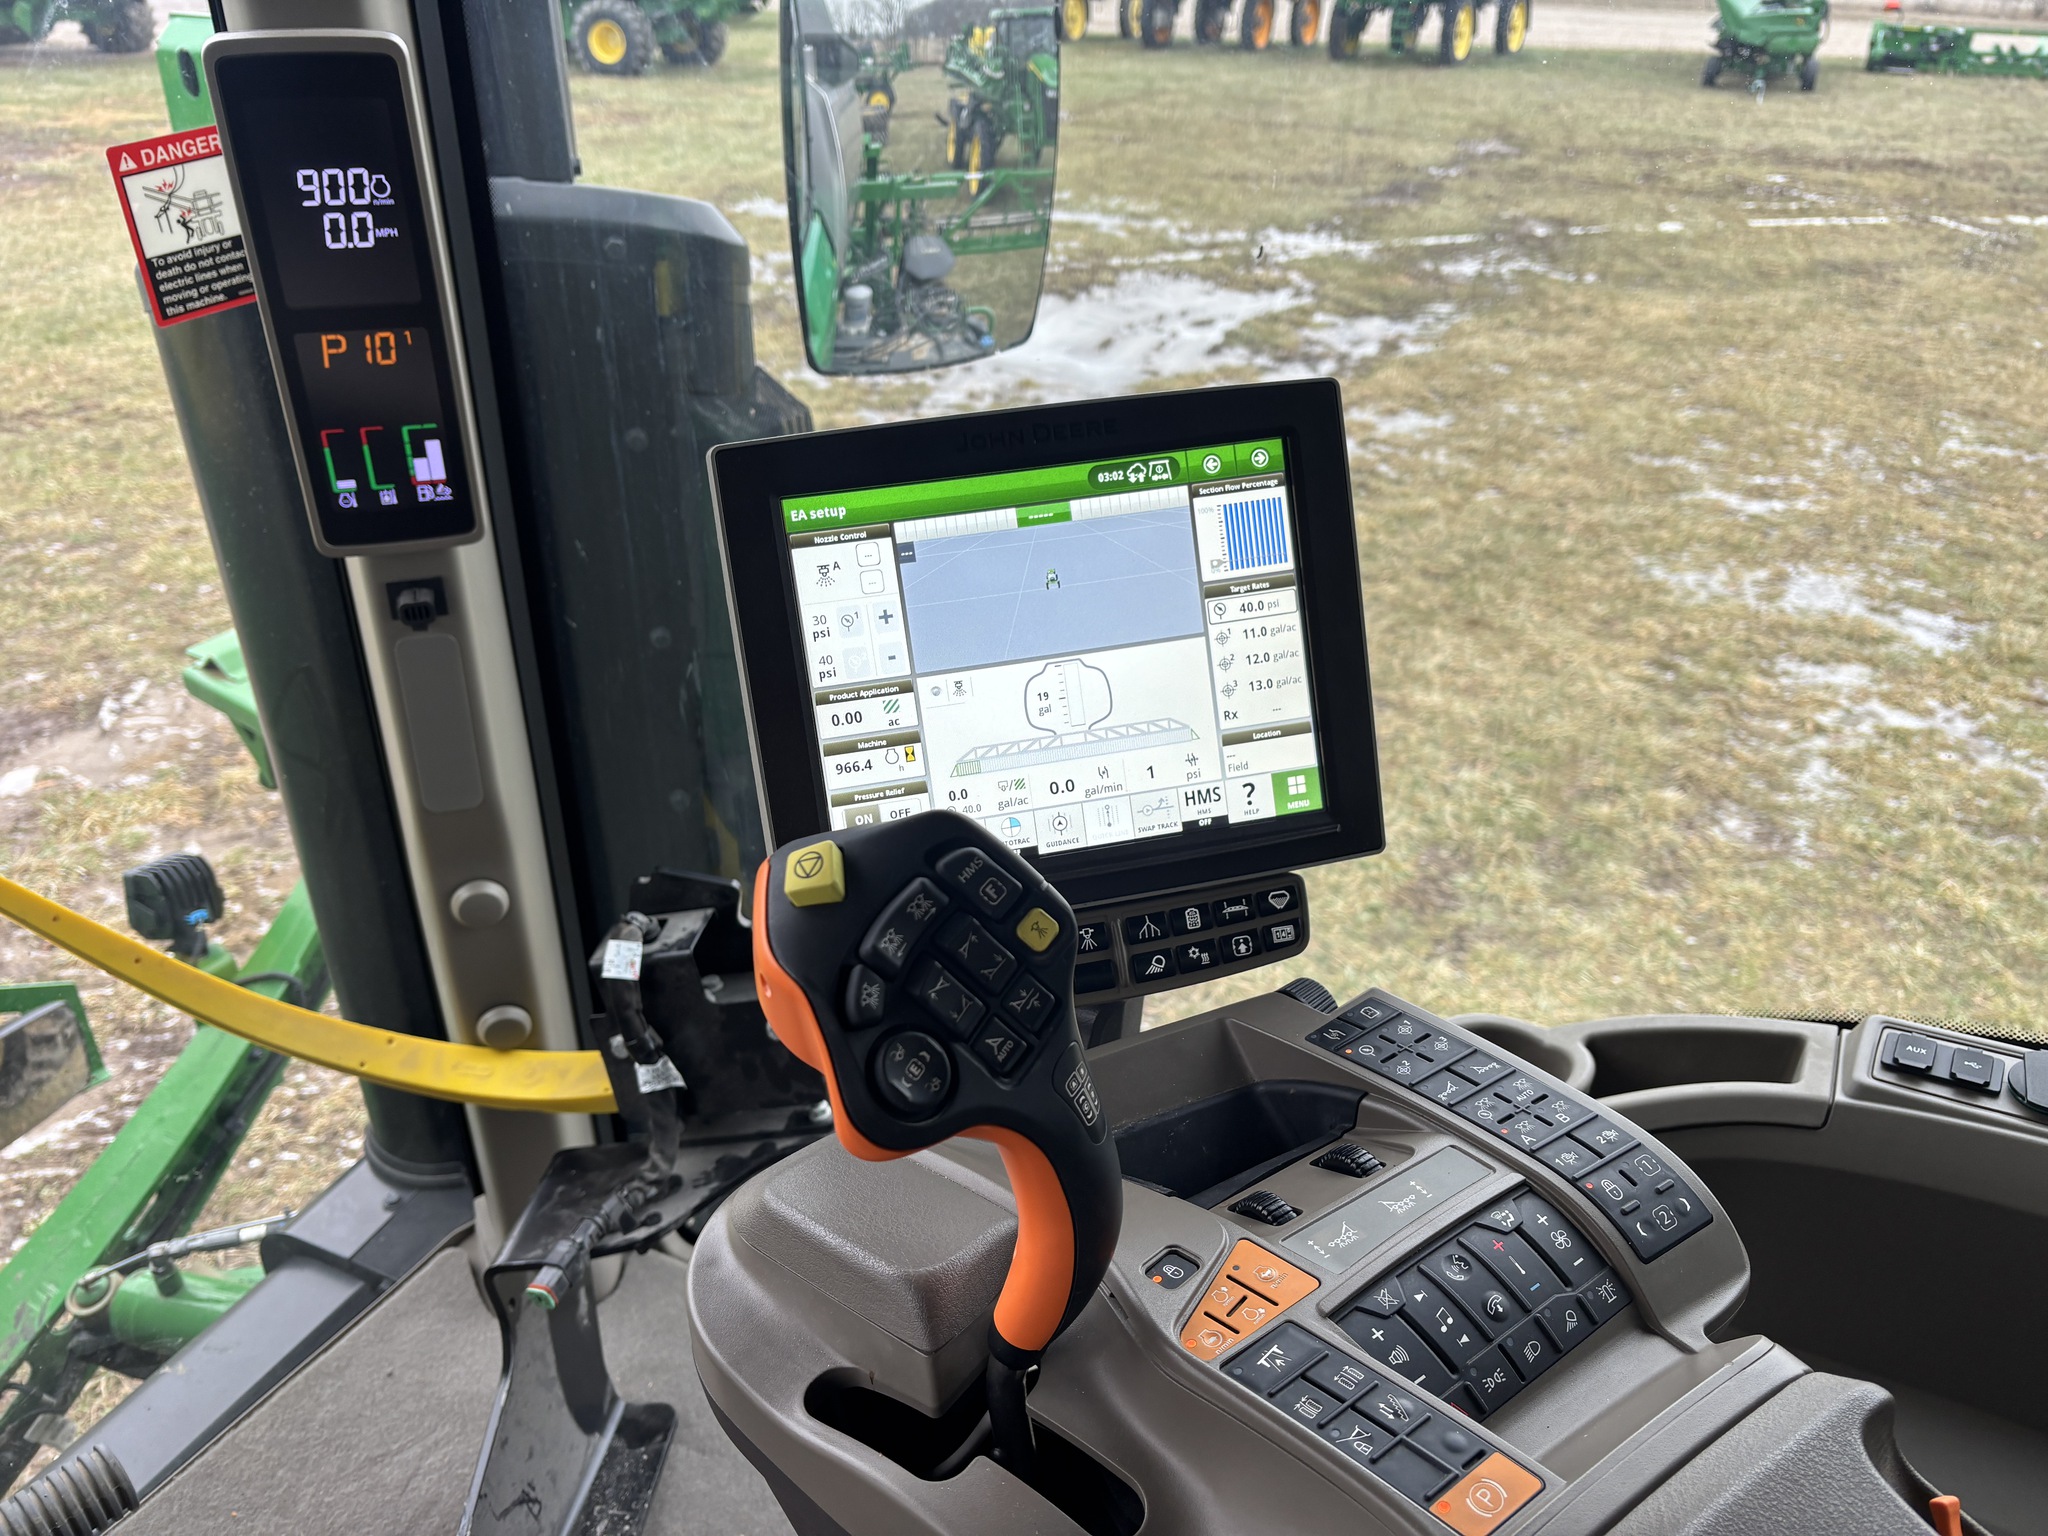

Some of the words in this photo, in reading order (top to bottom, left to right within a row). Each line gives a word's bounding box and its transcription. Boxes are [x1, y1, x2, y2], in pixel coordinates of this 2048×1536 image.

[141, 134, 222, 166] DANGER
[296, 167, 371, 207] 900
[323, 211, 375, 249] 0.0
[375, 227, 399, 238] MPH
[151, 258, 165, 268] To
[166, 249, 192, 264] avoid
[193, 243, 220, 257] injury
[222, 240, 232, 249] or
[155, 266, 183, 280] death
[183, 262, 197, 272] do
[198, 257, 214, 269] not
[215, 249, 246, 264] contac
[159, 276, 194, 292] electric
[194, 270, 218, 282] lines
[218, 263, 244, 276] when
[163, 288, 199, 304] moving
[199, 284, 209, 294] or
[166, 304, 185, 317] this
[321, 334, 348, 369] P
[364, 331, 397, 365] 10
[1032, 418, 1120, 443] DEERE
[1097, 471, 1124, 482] 03:02
[1199, 486, 1224, 495] Section
[1224, 484, 1241, 492] Flow
[1241, 479, 1279, 490] Percentage
[790, 509, 808, 522] EA
[809, 506, 847, 520] setup
[814, 534, 839, 544] Nozzle
[840, 531, 867, 541] Control
[833, 561, 841, 571] A
[1230, 583, 1251, 594] Target
[1252, 582, 1270, 591] Rates
[1239, 600, 1264, 613] 40.0
[1267, 599, 1280, 611] psi
[812, 615, 827, 626] 30
[812, 627, 831, 642] psi
[1242, 626, 1267, 639] 11.0
[1270, 624, 1297, 637] gal/ac
[819, 655, 833, 666] 40
[1246, 652, 1270, 665] 12.0
[1273, 650, 1299, 663] gal/ac
[819, 667, 837, 682] psi
[1248, 678, 1273, 692] 13.0
[1276, 676, 1302, 689] gal/ac
[829, 692, 858, 701] Product
[860, 686, 899, 698] Application
[1037, 692, 1049, 702] 19
[1038, 704, 1052, 716] gal
[1223, 710, 1239, 721] Rx
[831, 711, 863, 727] 0.00
[888, 718, 900, 726] ac
[1252, 729, 1281, 740] Location
[858, 739, 887, 749] Machine
[835, 759, 873, 775] 966.4
[899, 764, 904, 772] h
[1146, 765, 1155, 779] 1
[1228, 761, 1249, 773] Field
[1186, 769, 1201, 782] psi
[854, 791, 884, 801] Pressure
[885, 787, 905, 797] Relief
[1049, 779, 1075, 795] 0.0
[1085, 782, 1123, 798] gal/min
[948, 789, 968, 801] 0.0
[1185, 786, 1222, 807] HMS
[962, 804, 982, 814] 40.0
[998, 796, 1029, 811] gal/ac
[1287, 799, 1310, 810] MENU
[855, 814, 873, 825] ON
[890, 807, 911, 819] OFF
[1244, 808, 1260, 816] HELP
[1138, 824, 1156, 833] SWAP
[1158, 821, 1179, 830] TRACK
[1199, 818, 1212, 827] OFF
[1002, 837, 1030, 847] TOTRAC
[1046, 837, 1080, 848] GUIDANCE
[958, 856, 984, 883] HMS
[997, 1040, 1014, 1062] AUTO
[1906, 1045, 1927, 1055] AUX
[1516, 1089, 1534, 1102] AUTO
[1555, 1113, 1570, 1123] B
[1521, 1134, 1537, 1145] A
[1641, 1159, 1653, 1170] 1
[1658, 1211, 1671, 1225] 2
[1475, 1488, 1494, 1507] P
